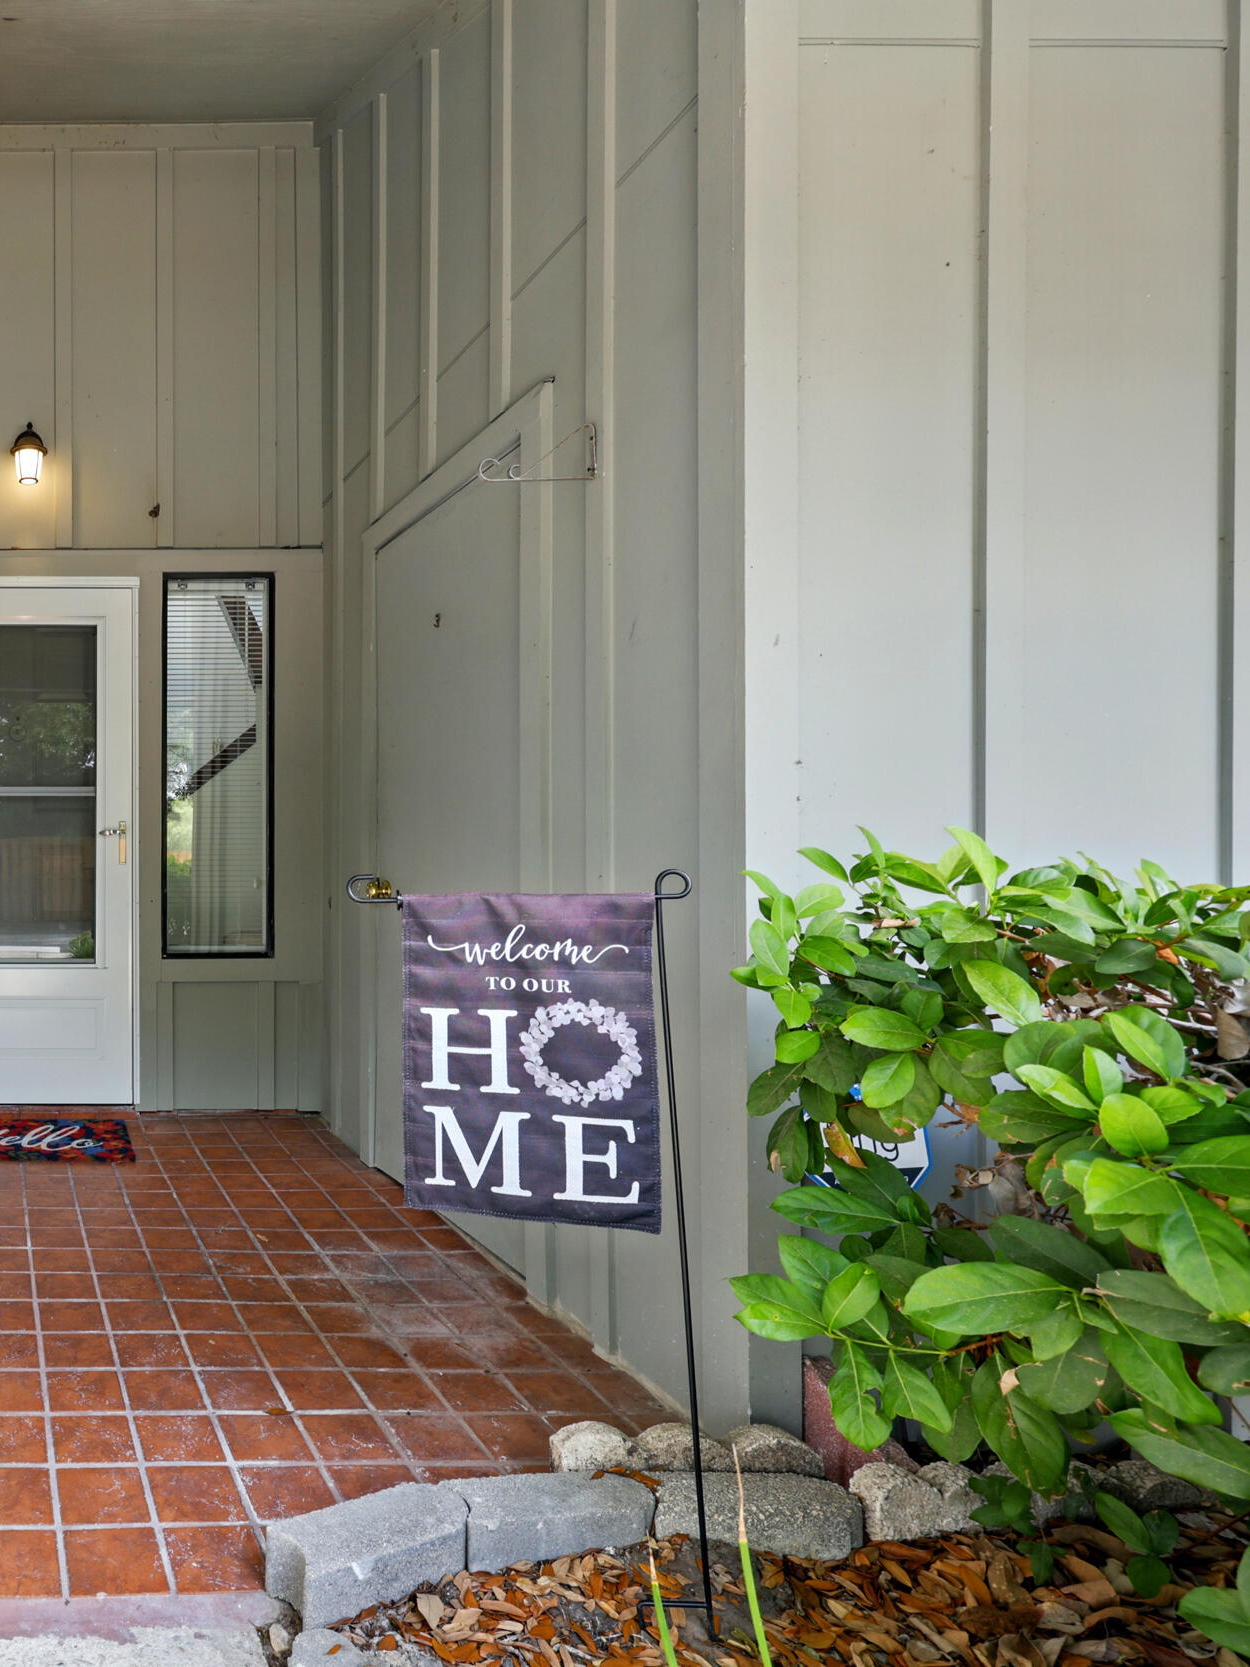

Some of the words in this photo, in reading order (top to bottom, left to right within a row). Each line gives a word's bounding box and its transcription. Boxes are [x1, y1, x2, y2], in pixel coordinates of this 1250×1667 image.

[427, 924, 629, 965] welcome
[485, 976, 516, 991] TO
[523, 978, 572, 993] OUR
